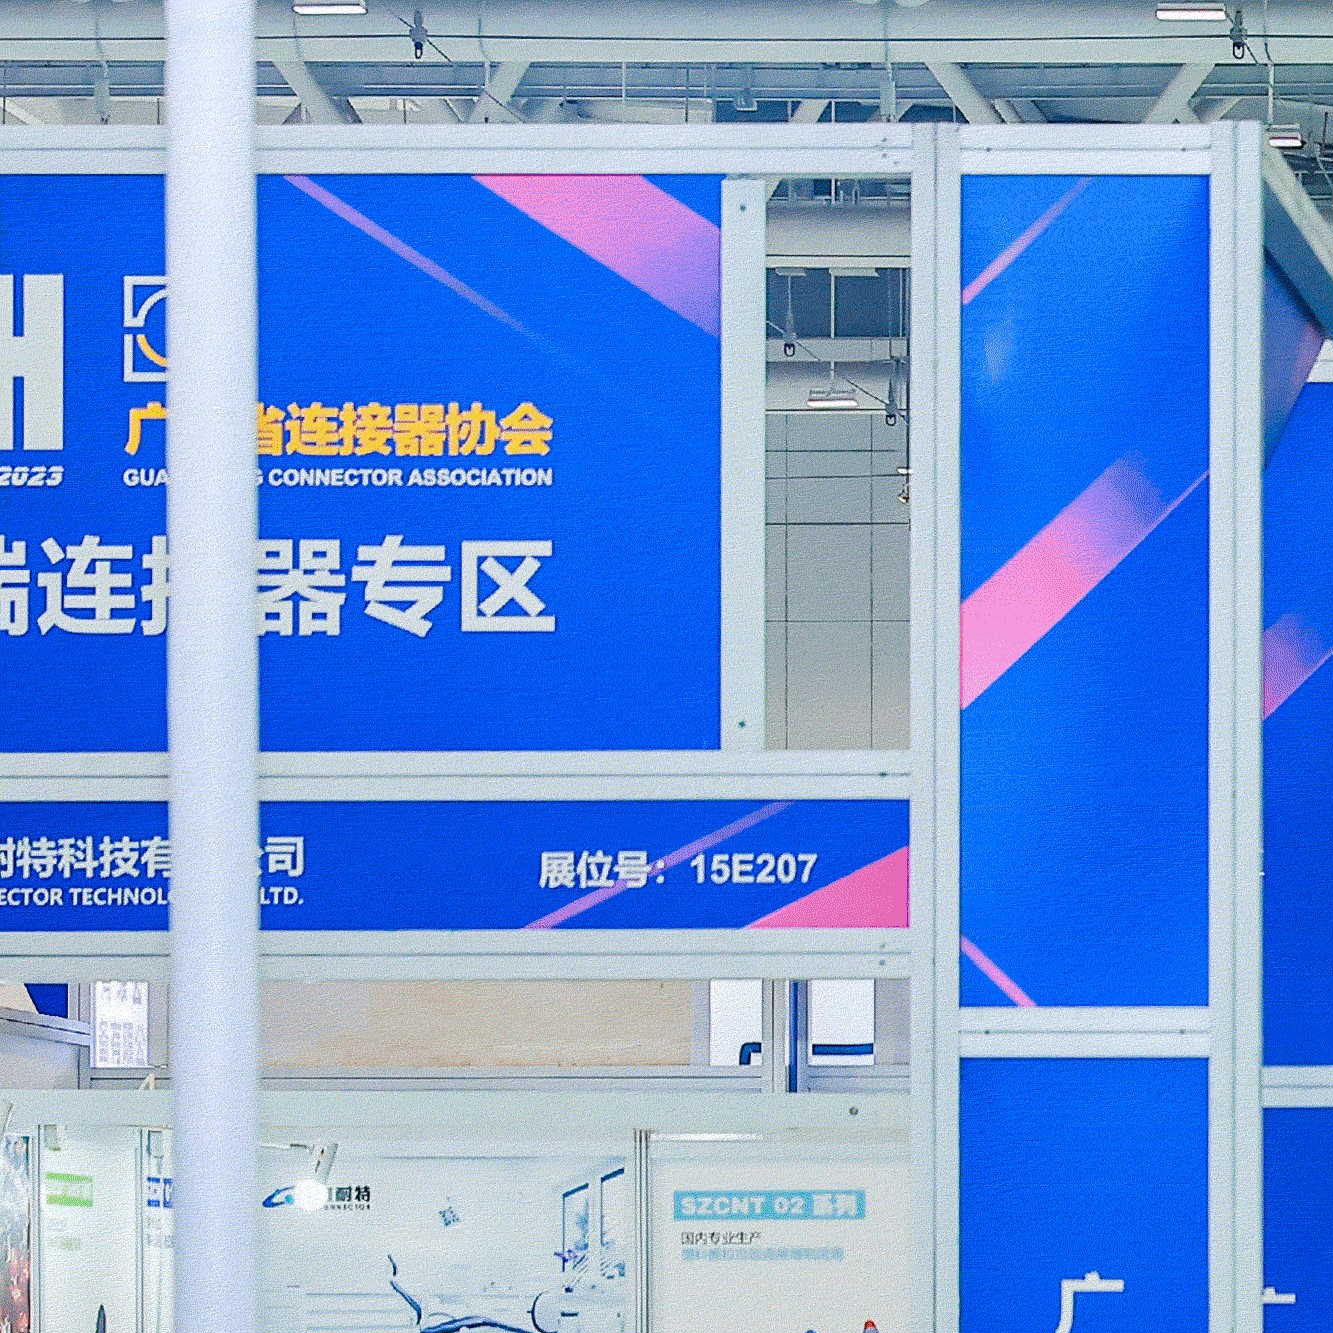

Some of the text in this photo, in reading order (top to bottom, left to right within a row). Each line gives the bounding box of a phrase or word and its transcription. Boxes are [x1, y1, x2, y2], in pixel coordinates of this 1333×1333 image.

[125, 402, 553, 456] 广省连接器协会
[268, 469, 402, 486] CONNECTOR
[407, 468, 553, 486] ASSOCIATION
[0, 835, 304, 879] 特科技有司
[690, 853, 818, 884] 15E207
[69, 888, 170, 906] TECHNOL
[681, 1196, 766, 1215] SZCNT
[774, 1197, 805, 1214] 02
